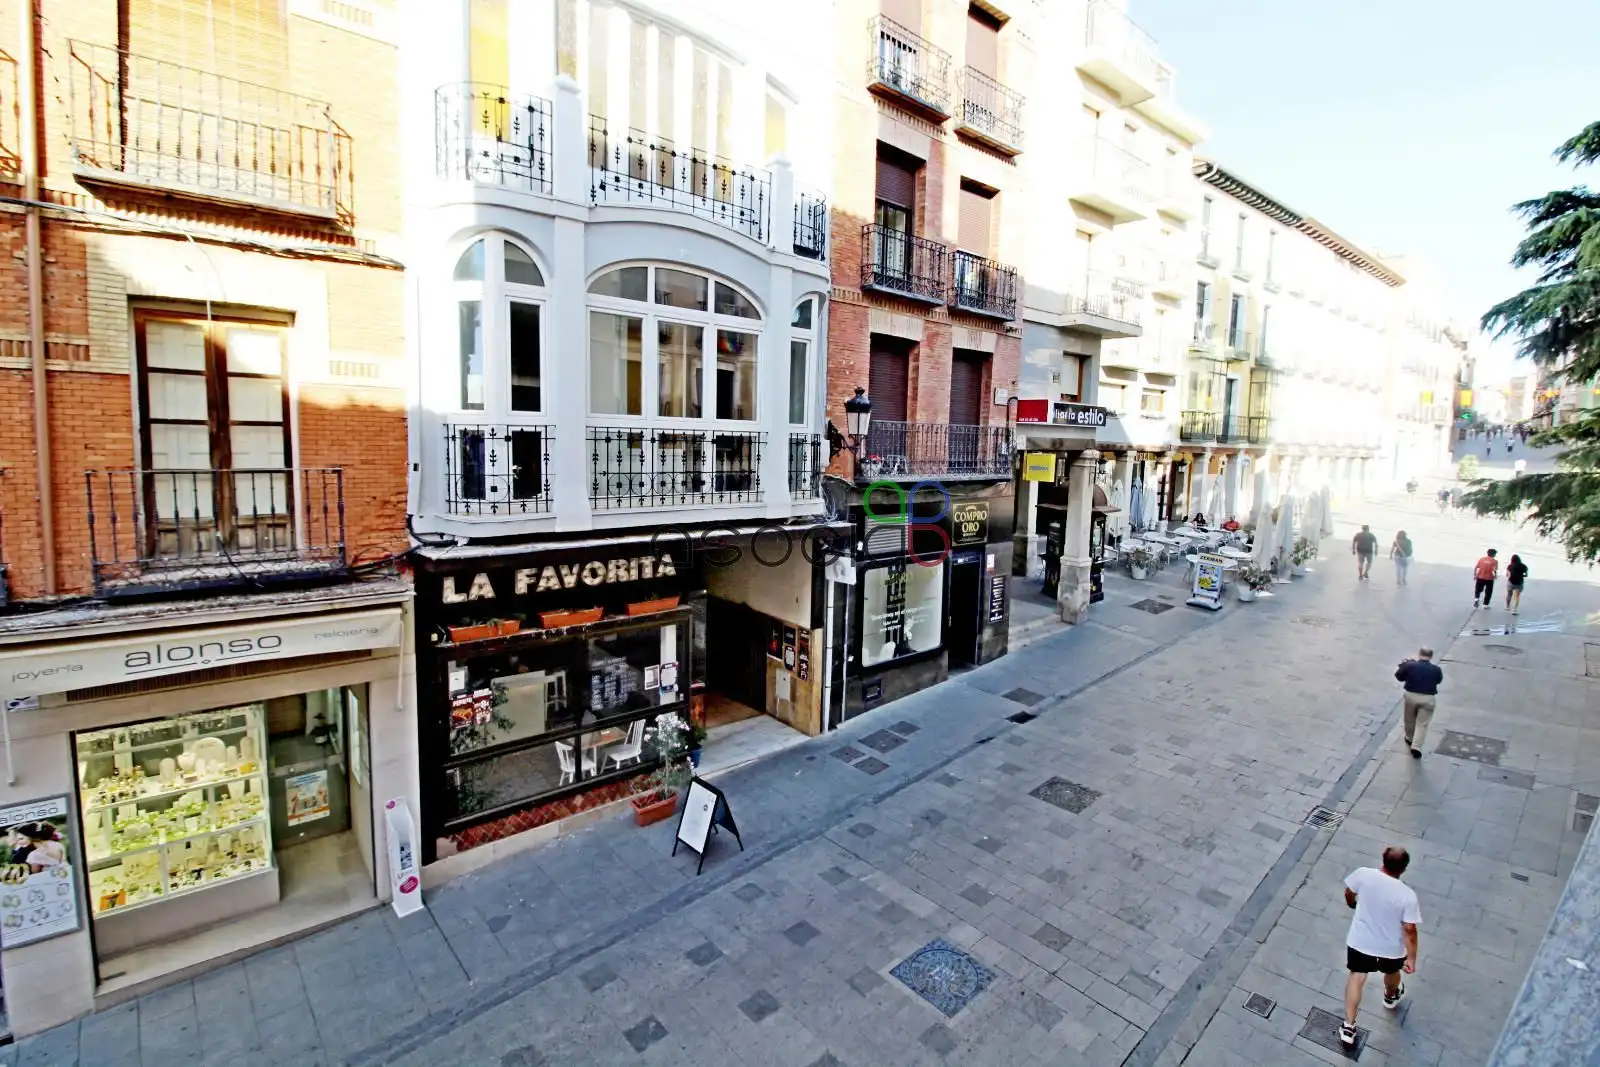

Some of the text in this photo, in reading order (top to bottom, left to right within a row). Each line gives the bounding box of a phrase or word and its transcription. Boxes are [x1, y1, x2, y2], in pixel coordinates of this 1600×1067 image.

[1078, 408, 1104, 425] estilo
[954, 510, 987, 522] COMPRO
[962, 521, 980, 532] ORO
[443, 554, 676, 603] LA FAVORITA
[125, 634, 282, 668] alonso
[0, 807, 58, 824] alonso
